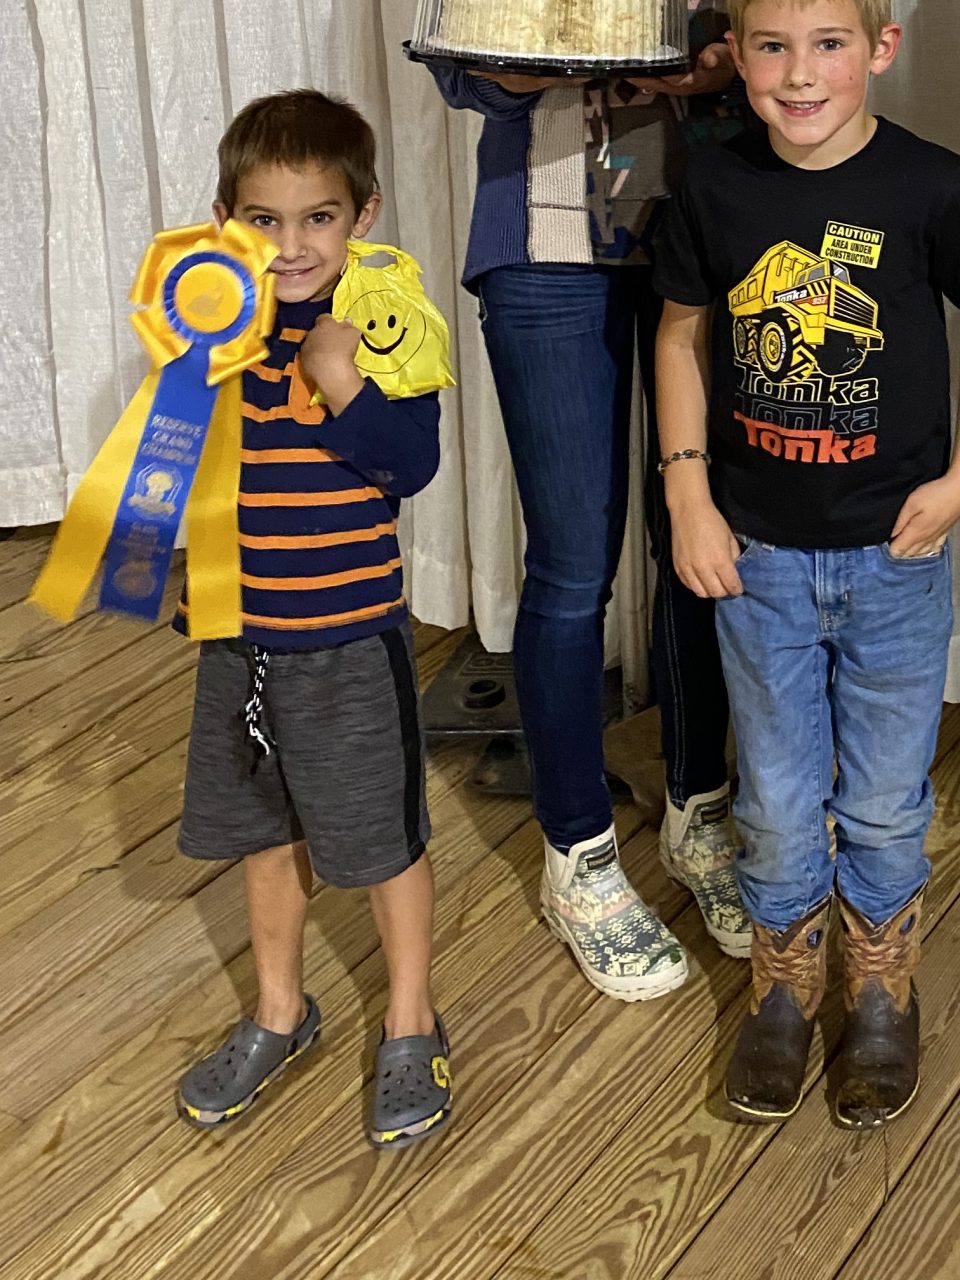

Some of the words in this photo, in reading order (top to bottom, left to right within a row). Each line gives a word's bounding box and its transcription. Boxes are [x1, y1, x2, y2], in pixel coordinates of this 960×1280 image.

[829, 224, 880, 243] CAUTION
[831, 238, 849, 250] AREA
[850, 242, 872, 255] UNDER
[825, 247, 874, 265] CONSTRUCTION
[775, 289, 807, 302] Tonka
[733, 410, 877, 464] Tonka
